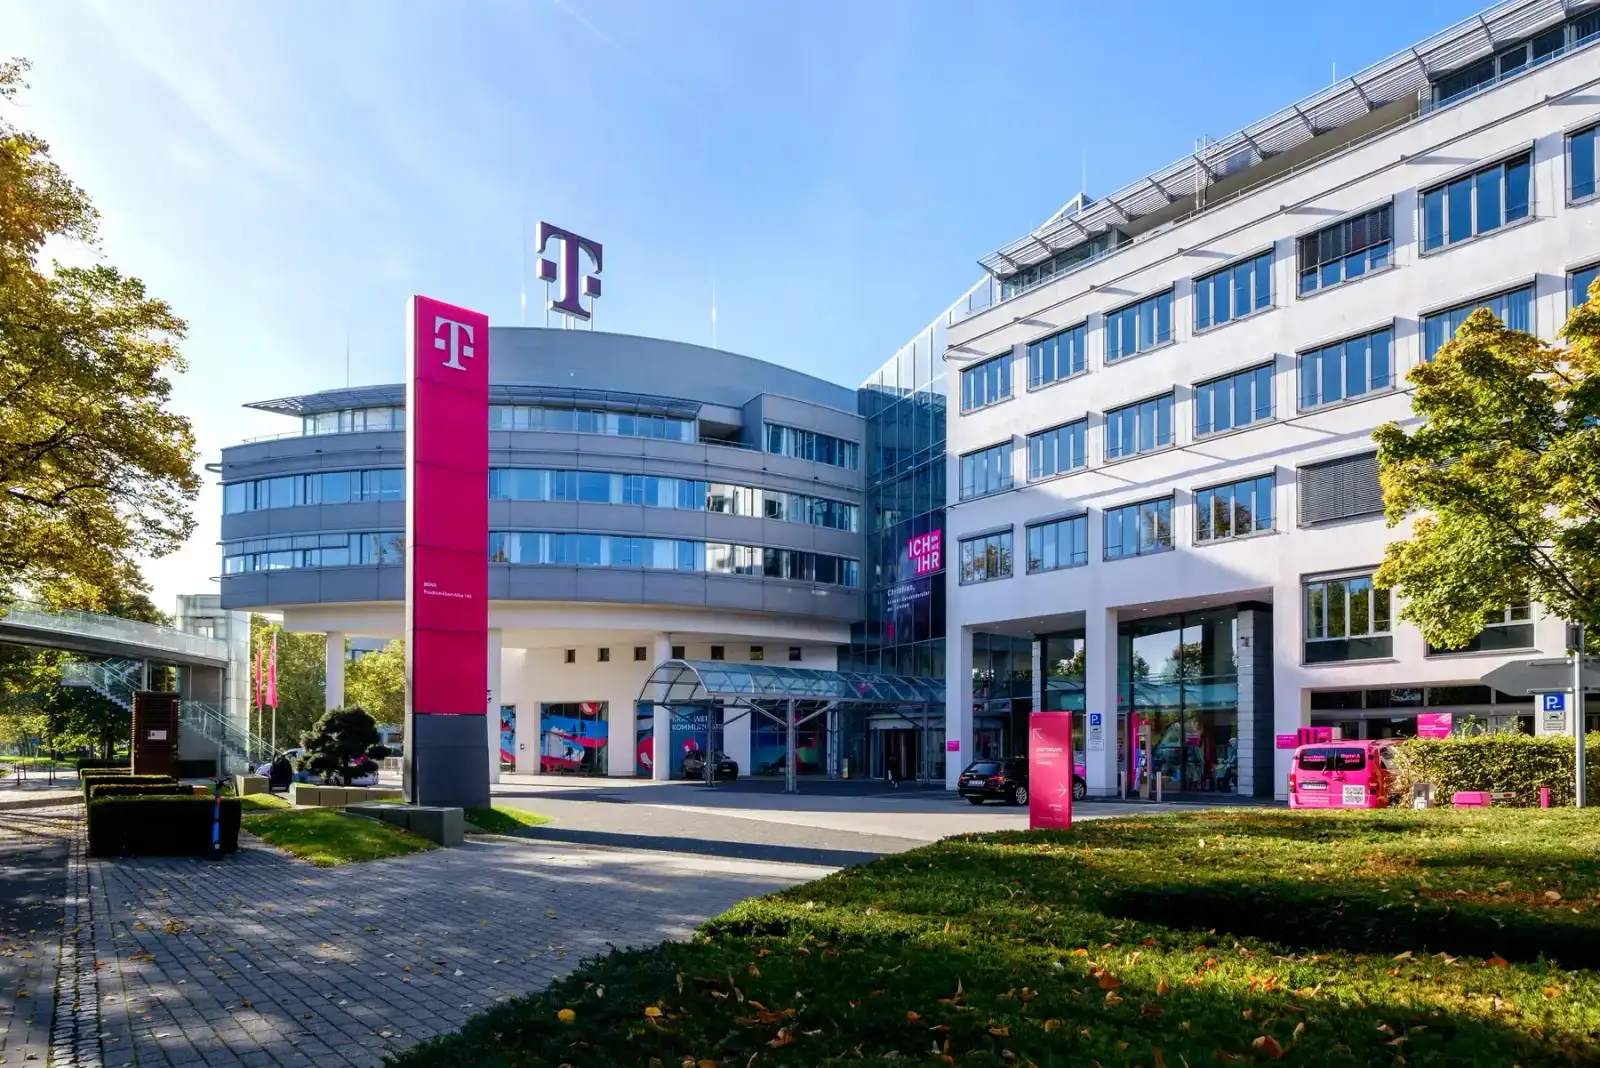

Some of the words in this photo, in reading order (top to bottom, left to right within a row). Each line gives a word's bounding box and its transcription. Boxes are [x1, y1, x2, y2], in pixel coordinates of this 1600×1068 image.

[535, 220, 603, 321] T
[434, 316, 474, 371] T
[909, 535, 930, 558] ICH
[917, 551, 939, 573] IHR
[1546, 696, 1558, 710] P
